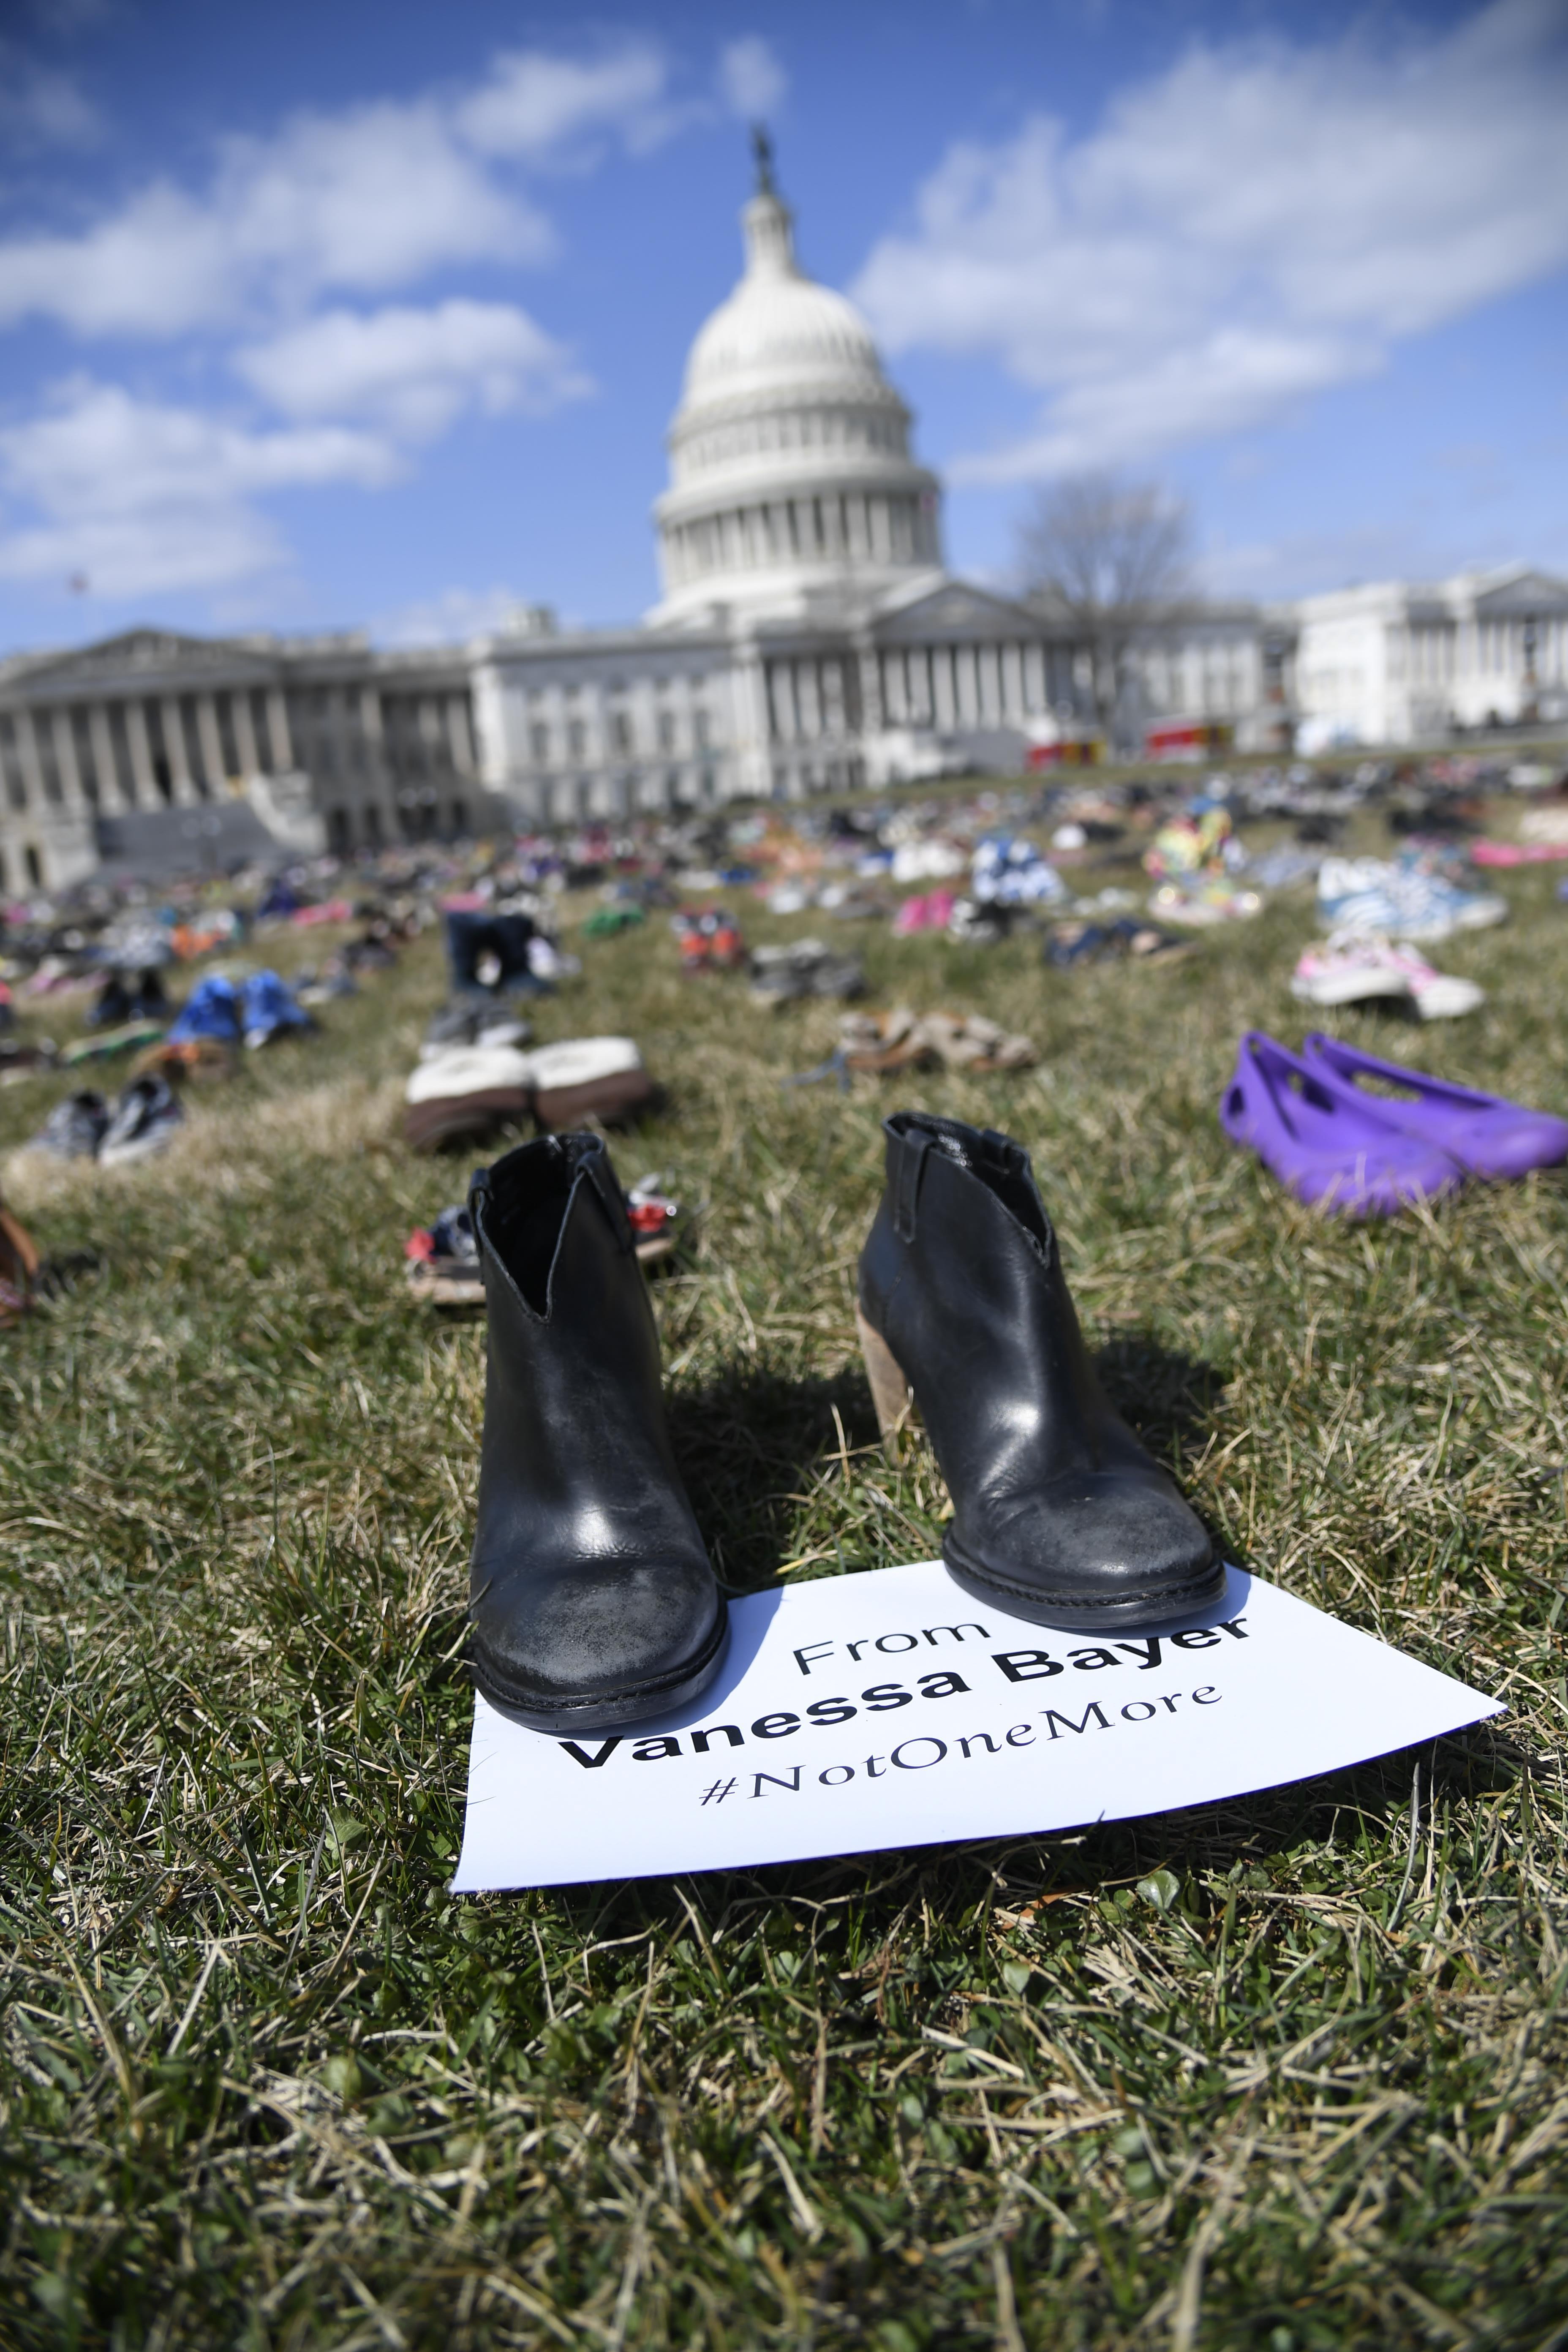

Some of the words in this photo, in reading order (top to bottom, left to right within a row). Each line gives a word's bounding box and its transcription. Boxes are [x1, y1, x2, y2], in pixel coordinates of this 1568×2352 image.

[558, 1671, 973, 1769] Vanessa
[991, 1617, 1250, 1682] Bayer
[793, 1624, 991, 1675] From
[699, 1686, 1222, 1806] #NotOneMore
